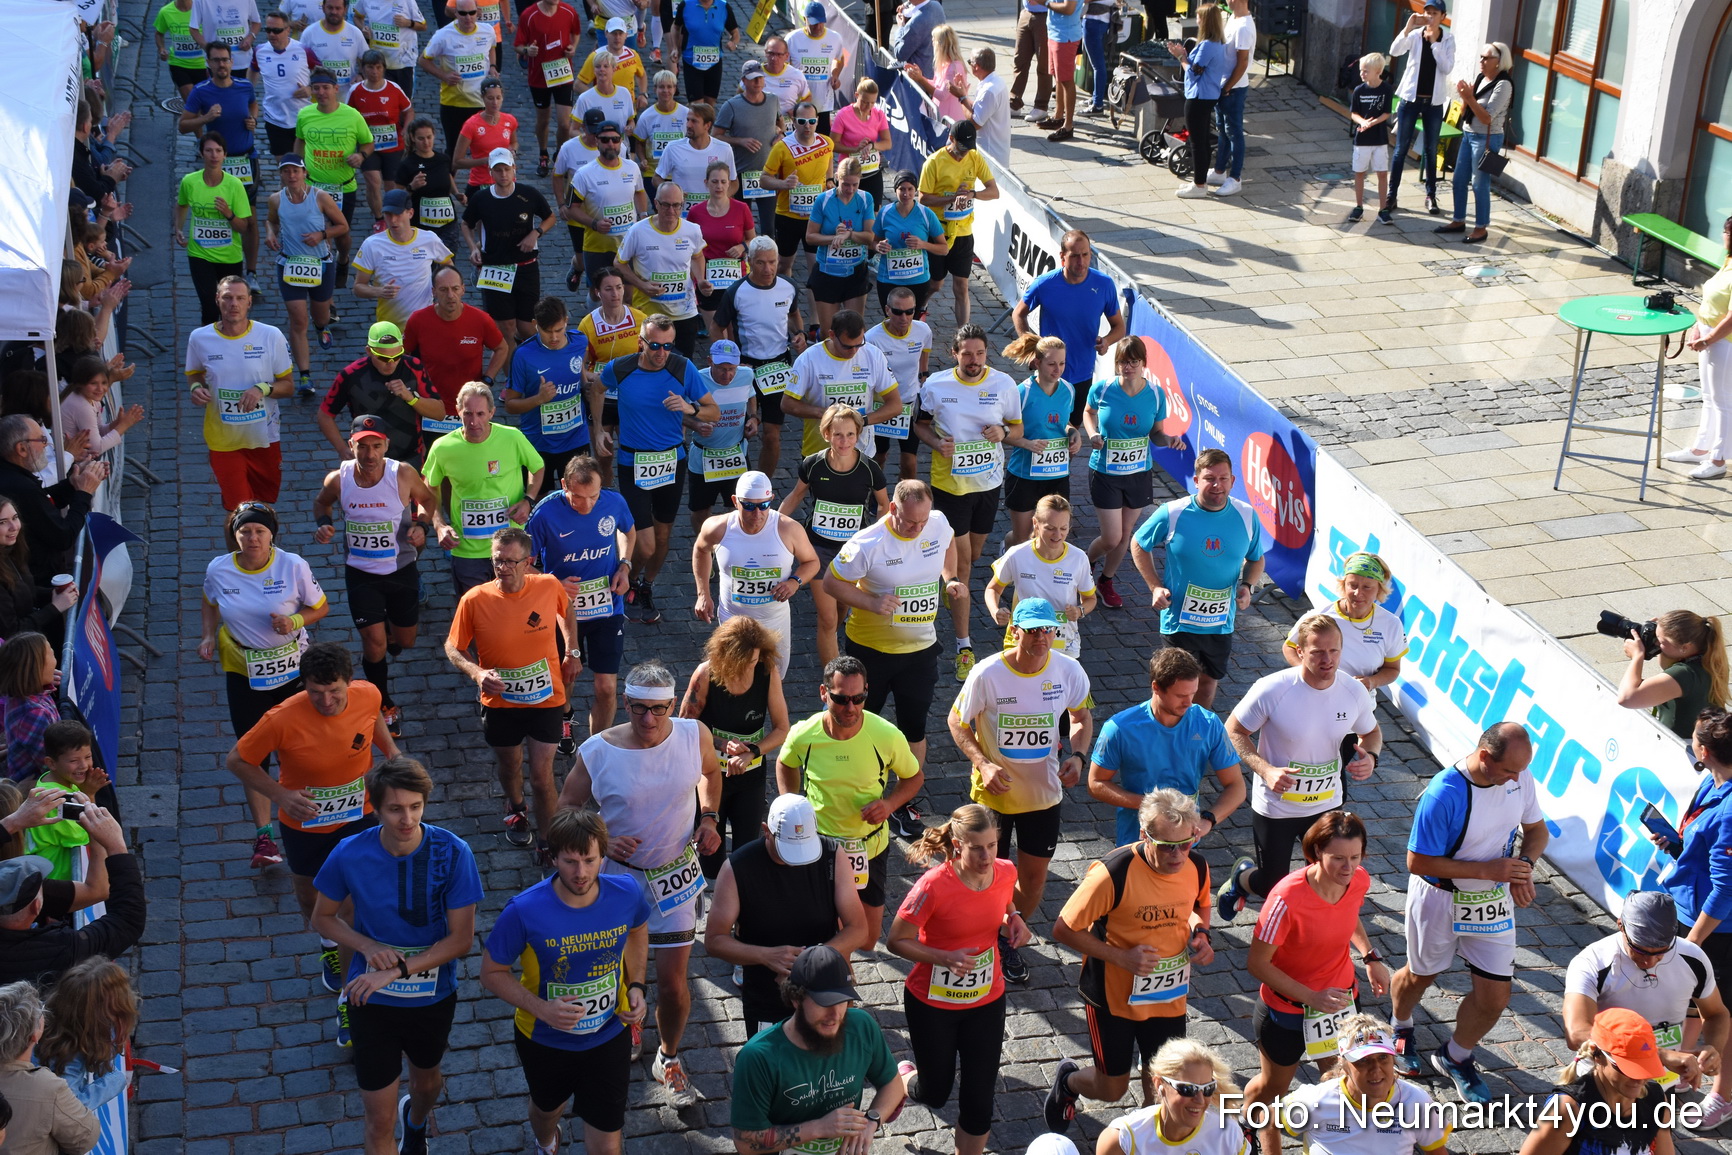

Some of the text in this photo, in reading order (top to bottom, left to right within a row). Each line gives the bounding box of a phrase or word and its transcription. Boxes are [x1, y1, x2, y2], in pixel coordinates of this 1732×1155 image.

[478, 12, 499, 22] 2537
[373, 30, 397, 41] 1205
[176, 42, 199, 51] 2802
[695, 53, 718, 63] 2052
[276, 63, 286, 78] 6
[459, 61, 484, 73] 2766
[547, 66, 570, 79] 1316
[804, 65, 828, 75] 2097
[656, 132, 682, 141] BOCK
[313, 149, 344, 158] MERZ
[794, 147, 832, 167] MAX BÖGL
[313, 157, 345, 165] PREMIUM
[423, 207, 452, 218] 1110
[604, 203, 633, 216] BOCK
[198, 229, 228, 239] 2086
[831, 247, 860, 259] 2468
[889, 249, 921, 257] BOCK
[288, 264, 319, 277] 1020
[709, 259, 738, 269] BOCK
[891, 258, 920, 270] 2464
[483, 267, 511, 282] 1112
[653, 272, 686, 281] BOCK
[710, 268, 739, 280] 2244
[484, 280, 505, 288] MARCO
[597, 330, 638, 345] MAX BÖGL
[755, 362, 790, 379] BOCK
[554, 380, 581, 395] ÄUFT
[825, 383, 867, 394] BOCK
[979, 390, 989, 398] 20
[542, 395, 579, 411] BOCK
[1196, 393, 1220, 418] STORE
[224, 411, 263, 422] CHRISTIAN
[546, 407, 578, 424] 2311
[429, 421, 457, 430] JÜRGEN
[552, 422, 576, 431] FABIAN
[876, 425, 909, 437] HARALD
[1204, 420, 1226, 448] ONLINE
[955, 440, 992, 452] BOCK
[1046, 438, 1067, 449] OCK
[1110, 438, 1147, 450] BOCK
[637, 450, 676, 464] BOCK
[705, 445, 741, 457] BOCK
[1036, 450, 1066, 465] 2469
[707, 456, 743, 469] 1368
[957, 451, 992, 467] 2309
[1111, 451, 1143, 466] 2467
[639, 463, 673, 476] 2074
[955, 463, 995, 475] MAXIMILIAN
[1042, 465, 1061, 473] KATHI
[1116, 463, 1139, 472] MARGA
[639, 475, 672, 488] CHRISTOF
[1246, 444, 1306, 534] Hervis
[464, 498, 505, 511] BOCK
[817, 504, 860, 515] BOCK
[466, 512, 505, 526] 2816
[818, 514, 855, 529] 2180
[348, 522, 391, 533] BOCK
[815, 527, 855, 539] CHRISTINE
[351, 533, 390, 548] 2736
[920, 539, 930, 549] 20
[563, 544, 612, 563] #LÄUFT
[734, 567, 780, 578] BOCK
[582, 578, 607, 592] OCK
[896, 584, 937, 597] BOCK
[1189, 585, 1231, 599] BOCK
[741, 595, 771, 605] STEFAN
[900, 599, 936, 613] 1095
[1187, 598, 1227, 615] 2465
[578, 605, 609, 616] RNHARD
[899, 614, 934, 624] GERHARD
[1189, 614, 1221, 623] MARKUS
[251, 642, 296, 661] BOCK
[253, 655, 297, 677] 2554
[498, 662, 545, 680] BOCK
[265, 674, 290, 686] MARA
[505, 675, 547, 694] 2475
[1041, 680, 1053, 691] 20
[513, 692, 541, 702] FRANZ
[1003, 716, 1050, 727] BOCK
[1003, 730, 1050, 747] 2706
[1296, 762, 1336, 777] BOCK
[311, 781, 361, 800] BOCK
[1294, 776, 1334, 792] 1177
[1302, 794, 1319, 802] JAN
[315, 796, 358, 815] 2474
[317, 811, 349, 823] FRANZ
[650, 848, 695, 879] BOCK
[657, 861, 698, 897] 2008
[674, 884, 698, 905] PETER
[1459, 889, 1503, 903] BOCK
[1460, 902, 1507, 923] 2194
[1458, 922, 1509, 933] BERNHARD
[544, 924, 628, 948] 10. NEUMARKTER
[560, 937, 618, 956] STADTLAUF
[940, 969, 989, 988] 1231
[1139, 968, 1185, 993] 2751
[387, 983, 421, 992] ULIAN
[558, 978, 612, 997] BOCK
[945, 989, 980, 999] SIGRID
[572, 1016, 606, 1031] ANUEL
